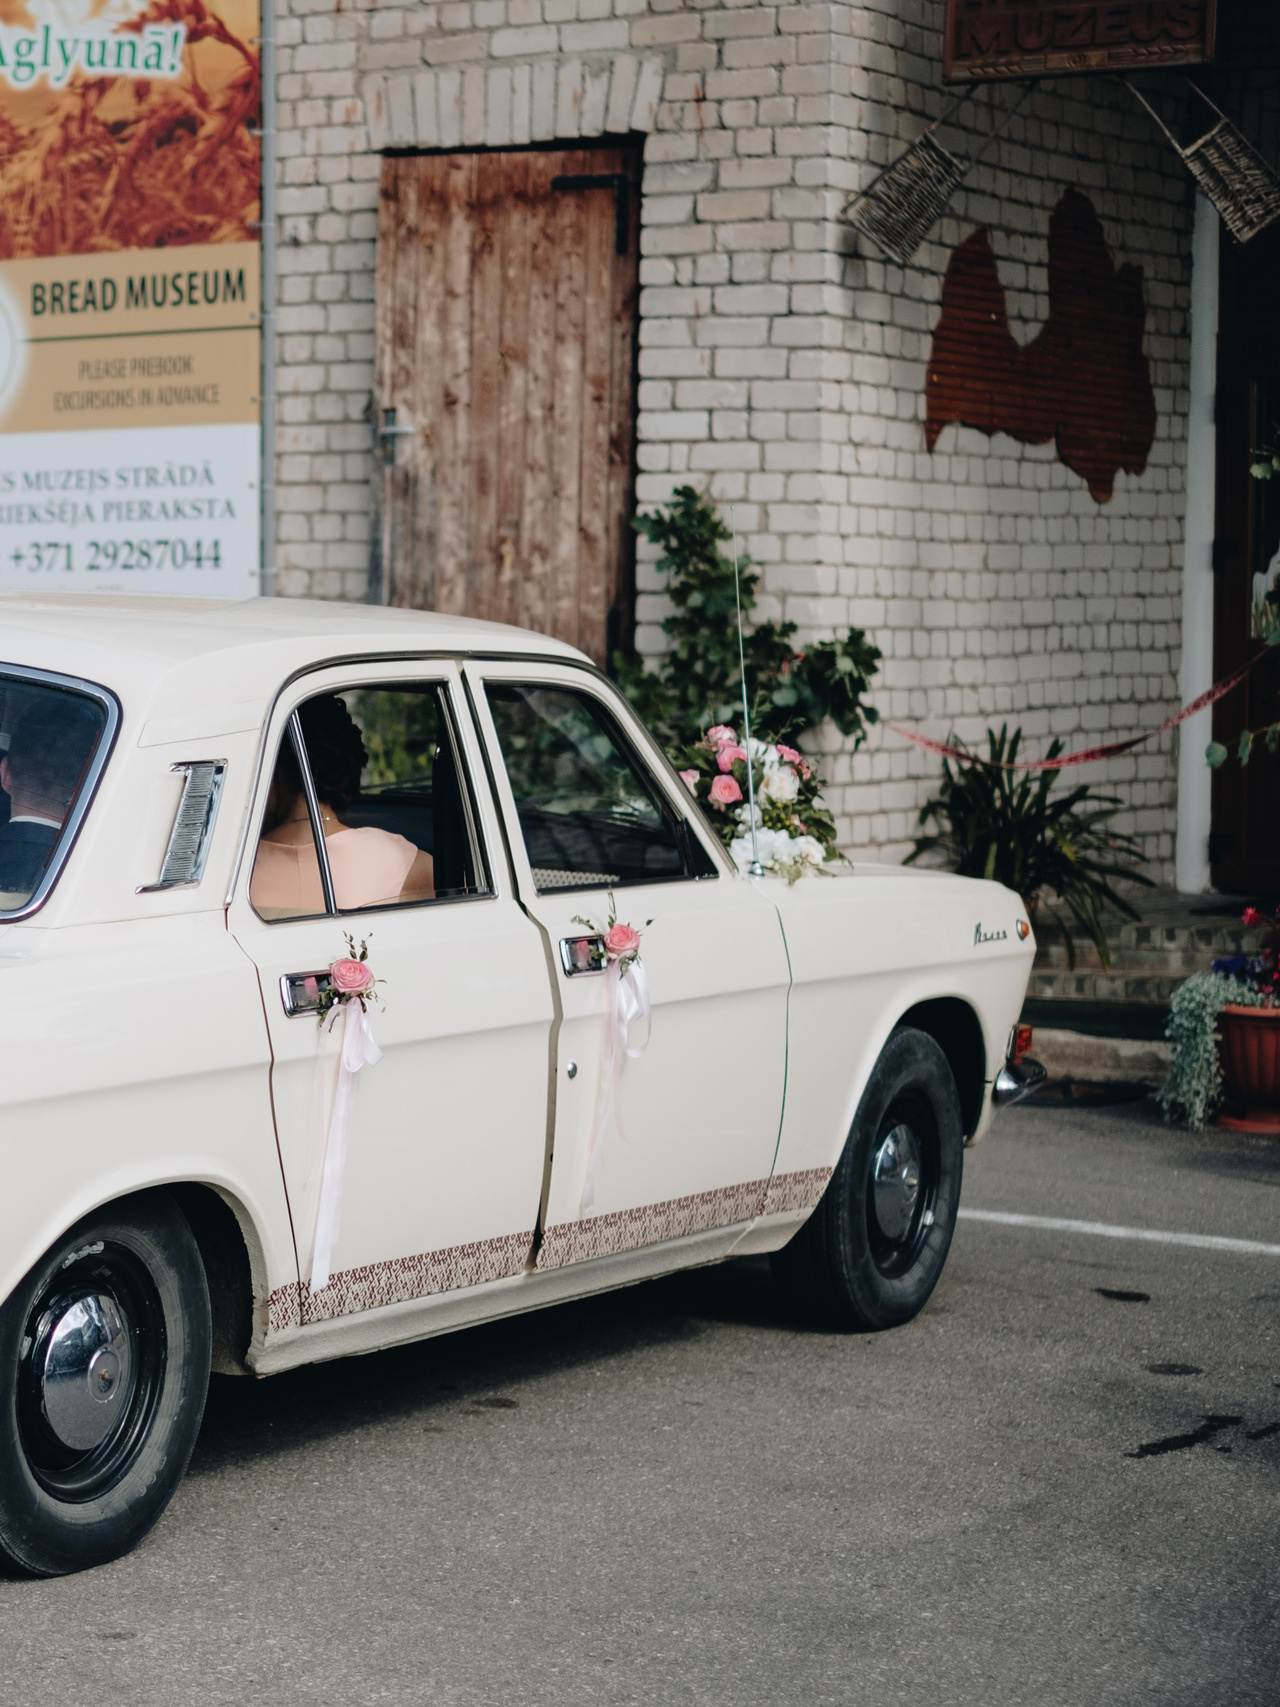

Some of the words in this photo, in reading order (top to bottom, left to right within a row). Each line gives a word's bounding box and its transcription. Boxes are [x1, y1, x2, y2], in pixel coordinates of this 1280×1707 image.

[32, 277, 117, 316] BREAD
[125, 268, 246, 310] MUSEUM
[78, 358, 126, 380] PLEASE
[137, 387, 153, 408] IN
[21, 468, 109, 494] MUZEJS
[116, 461, 215, 489] STRĀDĀ
[102, 498, 237, 523] PIERAKSTA
[10, 542, 74, 572] +371
[86, 539, 221, 571] 29287044
